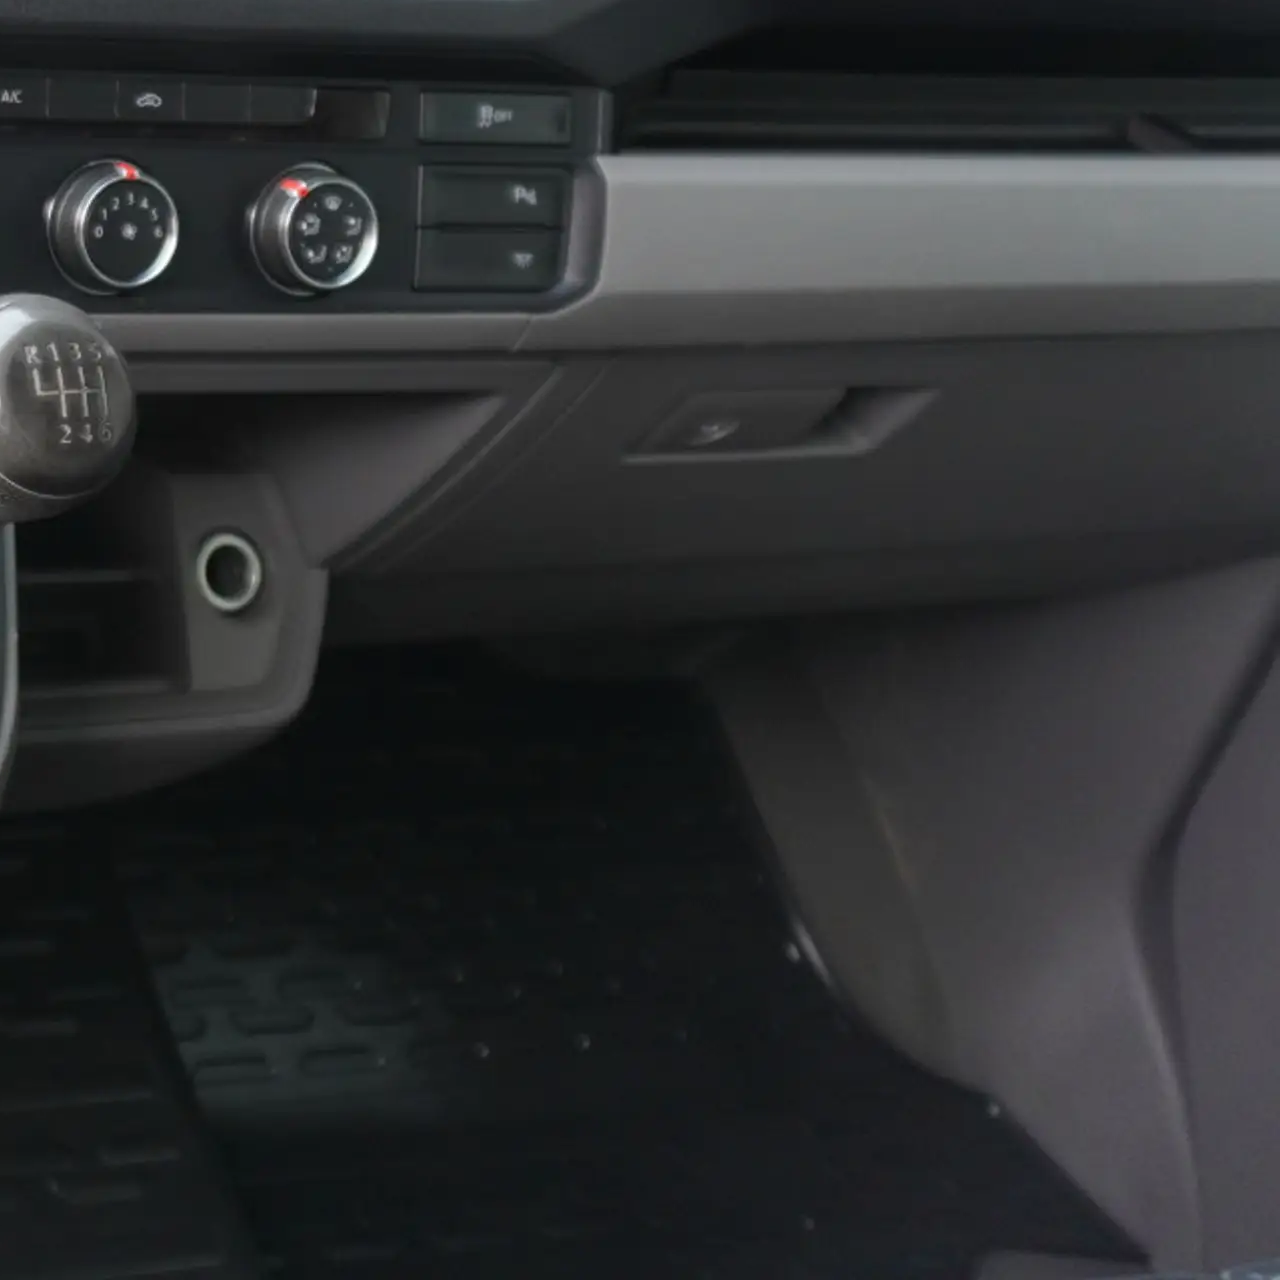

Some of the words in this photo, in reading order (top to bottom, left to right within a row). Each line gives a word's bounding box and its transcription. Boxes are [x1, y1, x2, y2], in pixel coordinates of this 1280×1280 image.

[94, 227, 103, 238] 0
[112, 198, 120, 210] 2
[126, 193, 135, 205] 3
[141, 197, 149, 209] 4
[24, 345, 42, 364] R
[46, 342, 59, 361] 1
[69, 342, 81, 360] 3
[60, 424, 71, 443] 2
